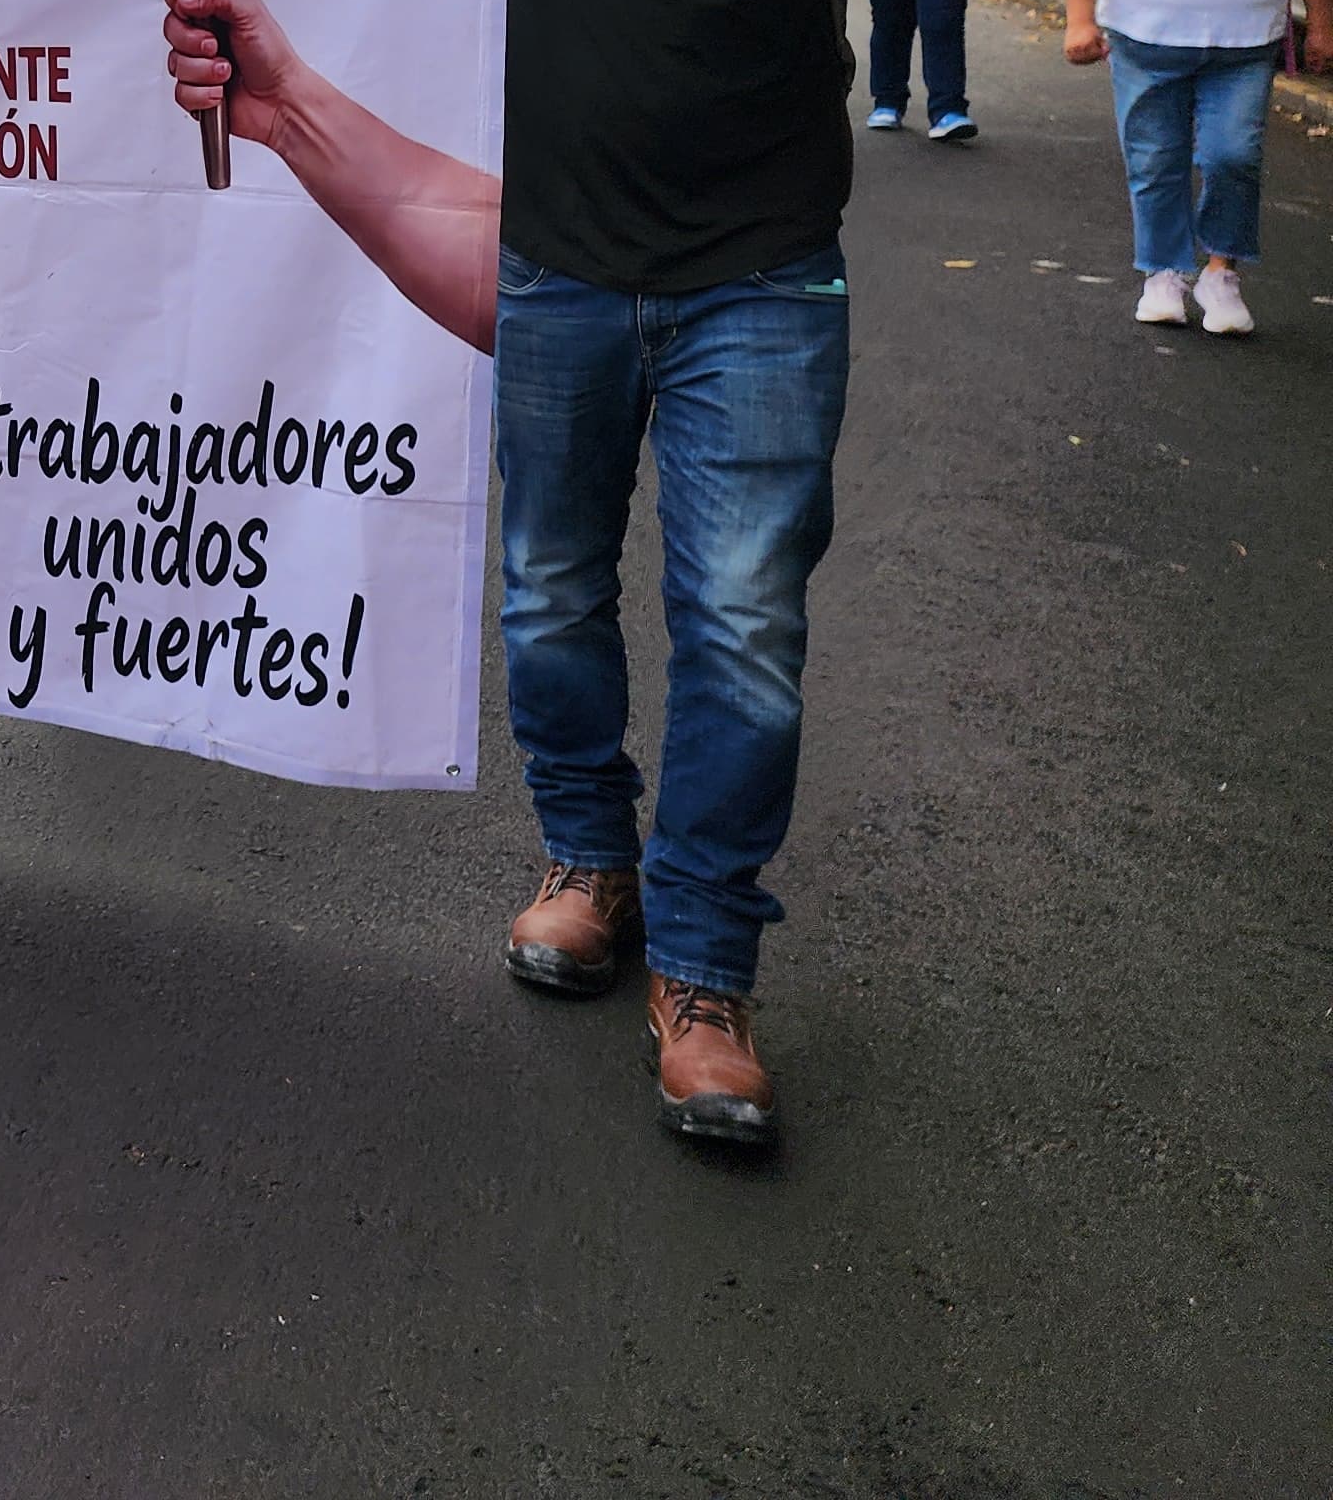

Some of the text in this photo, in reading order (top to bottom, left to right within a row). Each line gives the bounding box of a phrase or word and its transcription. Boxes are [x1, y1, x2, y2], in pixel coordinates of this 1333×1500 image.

[43, 486, 268, 589] unidos
[8, 581, 365, 710] y fuertes!
